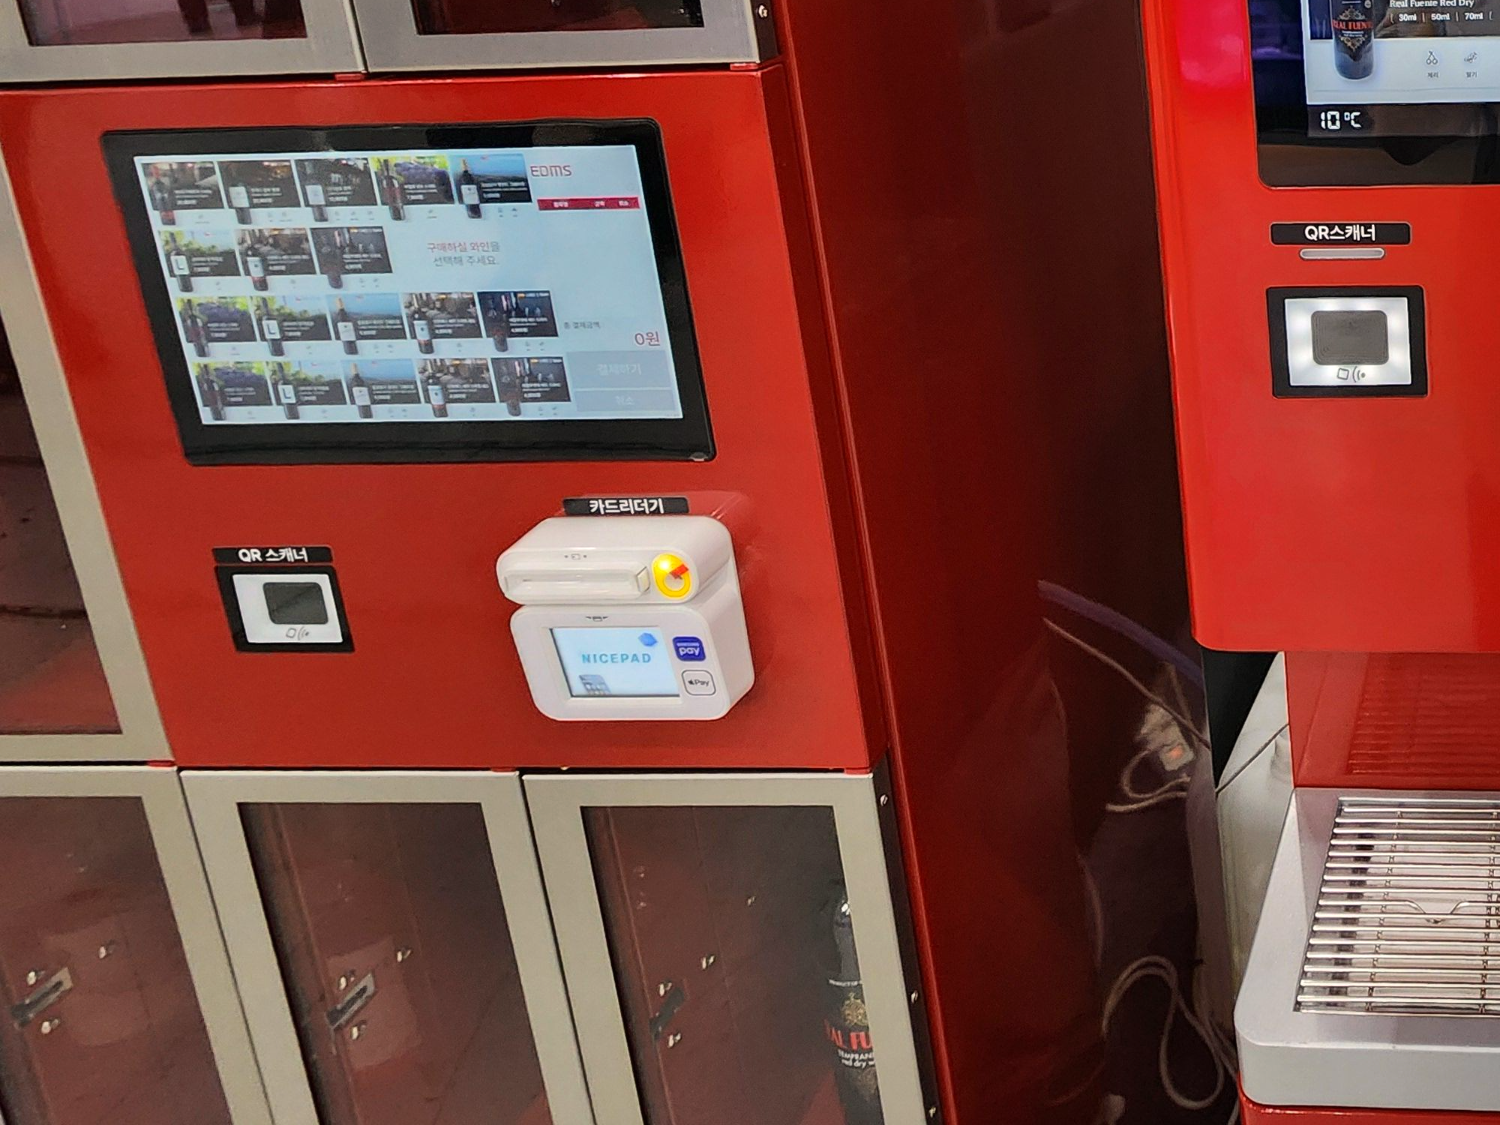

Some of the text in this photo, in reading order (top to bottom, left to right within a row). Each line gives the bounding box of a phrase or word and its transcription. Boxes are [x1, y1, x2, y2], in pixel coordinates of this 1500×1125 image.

[1410, 0, 1438, 8] Fuente
[1398, 13, 1417, 22] 30ml
[1464, 12, 1483, 21] 70ml
[1304, 223, 1376, 242] QR스캐너
[588, 497, 666, 515] 카드리더기
[679, 647, 701, 656] pay
[581, 651, 653, 665] NICEPAD
